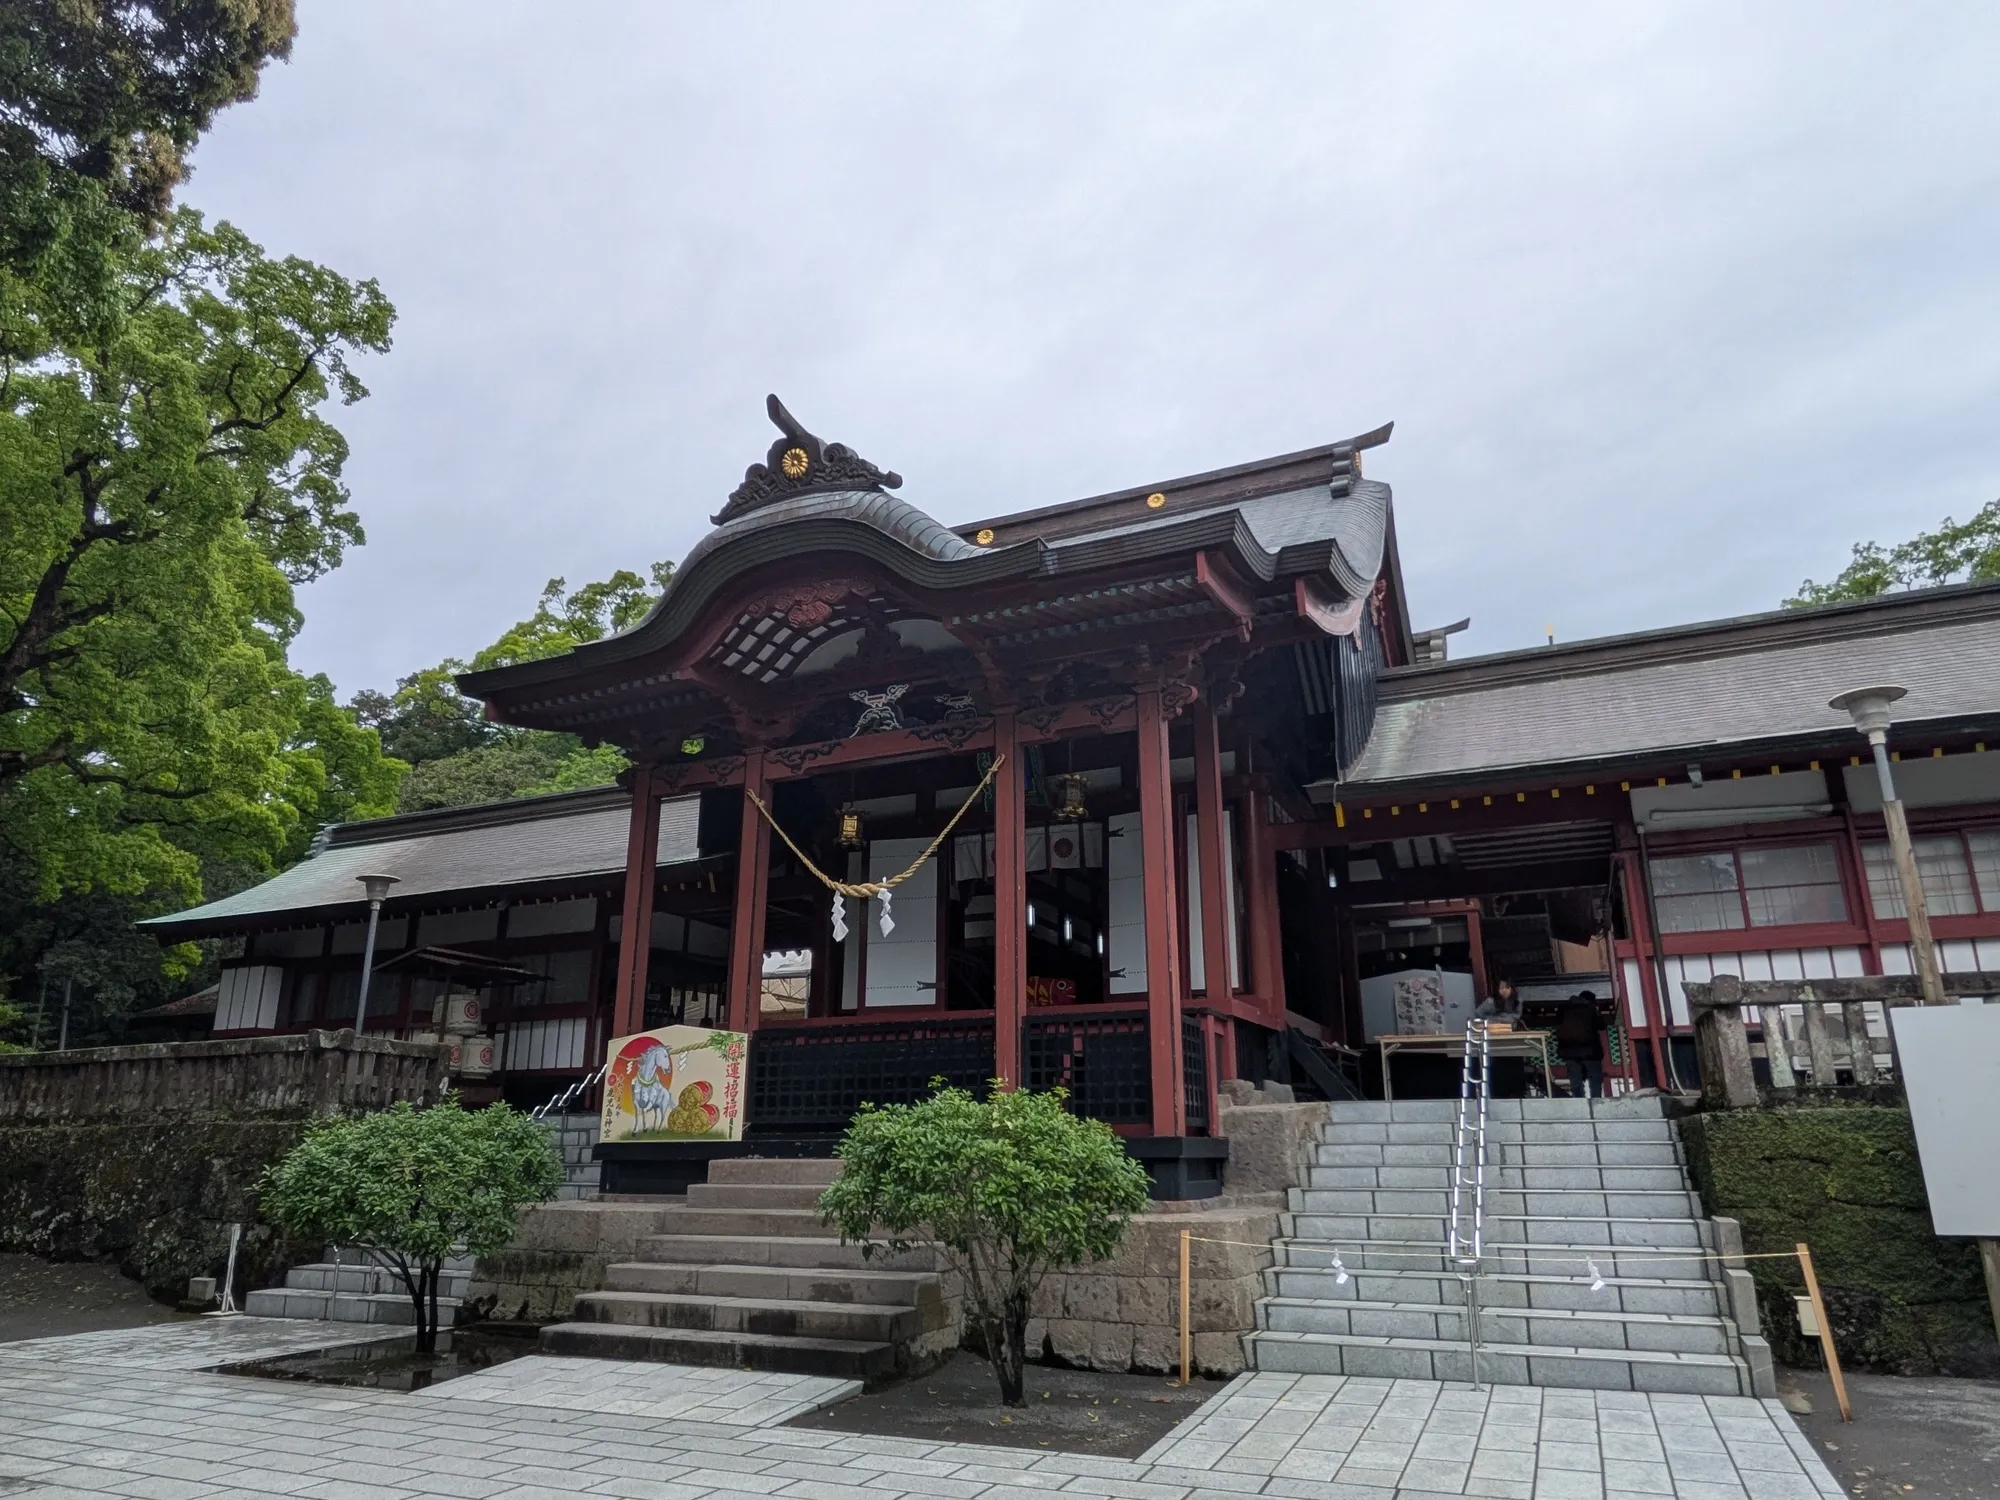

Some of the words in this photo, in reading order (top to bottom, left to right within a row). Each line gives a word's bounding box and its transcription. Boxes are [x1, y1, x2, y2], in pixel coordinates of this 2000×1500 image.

[723, 1042, 741, 1119] 開運招福
[604, 1087, 615, 1139] 鹿児島神宮
